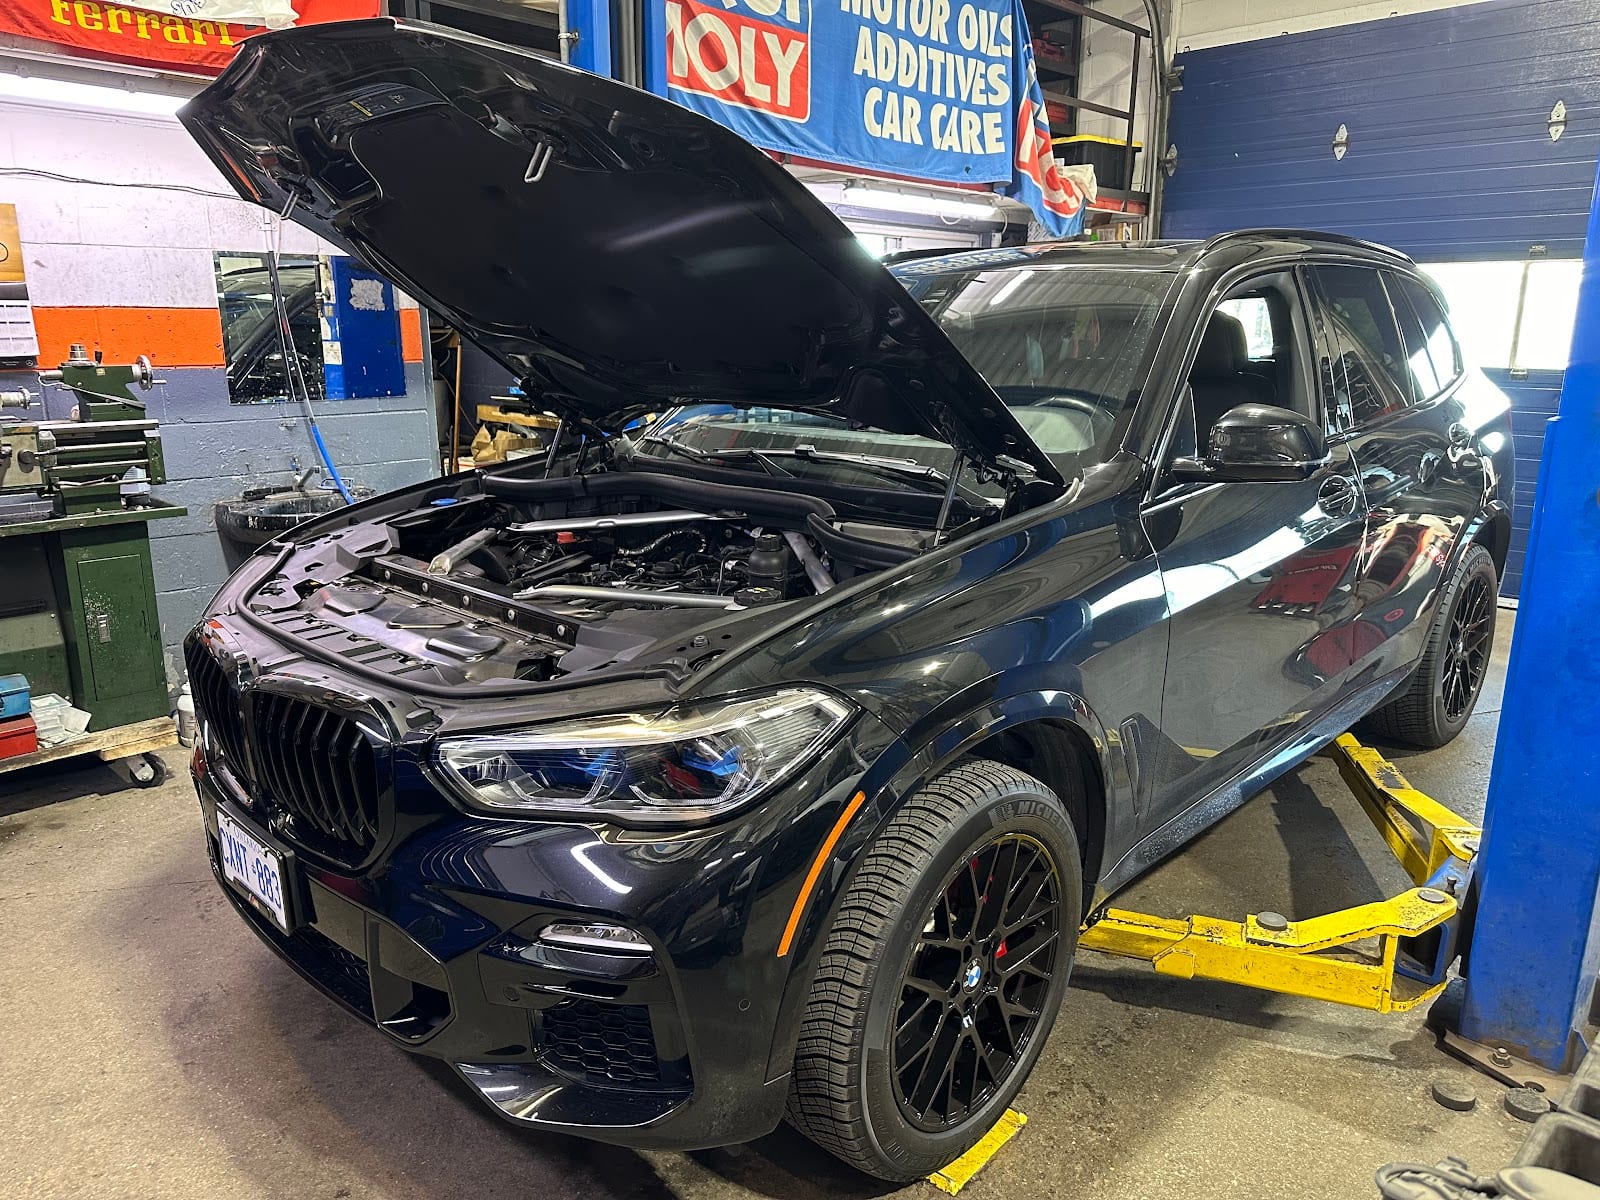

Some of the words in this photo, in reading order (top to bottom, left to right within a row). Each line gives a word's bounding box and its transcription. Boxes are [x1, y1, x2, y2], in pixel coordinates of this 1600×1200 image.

[840, 0, 950, 45] OTOR
[958, 4, 1012, 58] OILS
[853, 25, 1011, 106] ADDITIVES
[864, 87, 923, 146] CAR
[930, 103, 1006, 155] CARE
[1018, 801, 1070, 840] MICHEL
